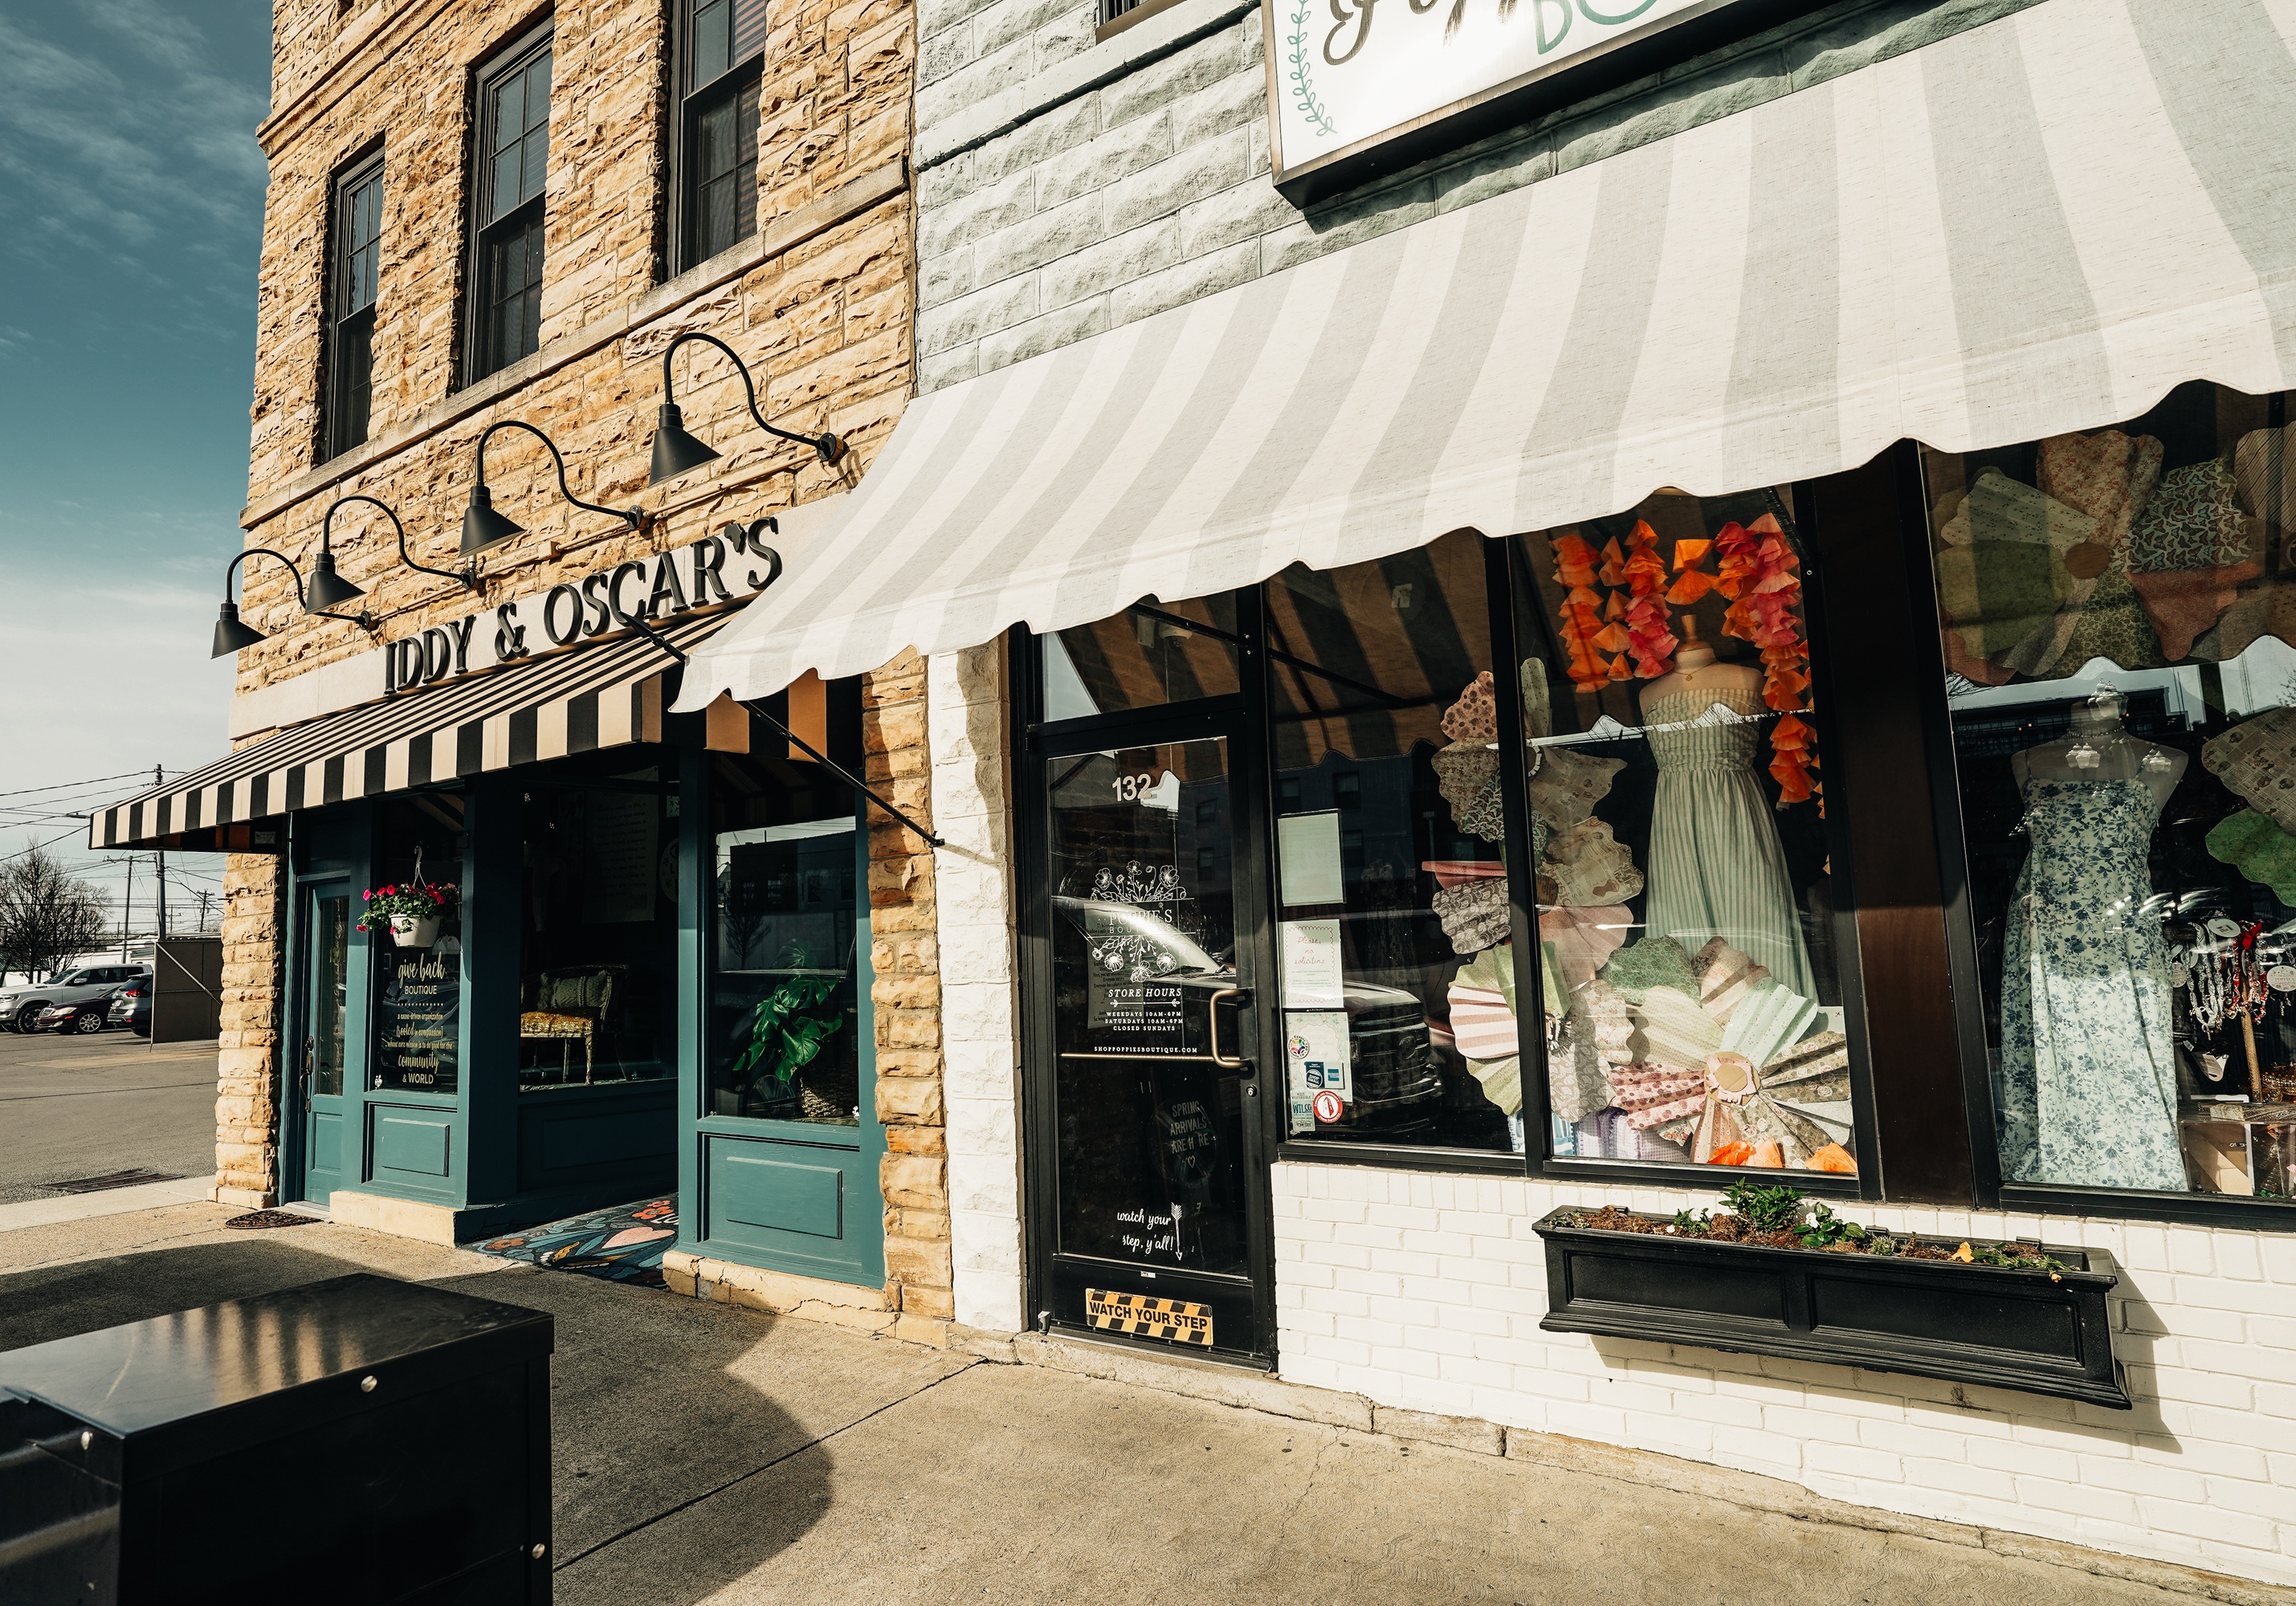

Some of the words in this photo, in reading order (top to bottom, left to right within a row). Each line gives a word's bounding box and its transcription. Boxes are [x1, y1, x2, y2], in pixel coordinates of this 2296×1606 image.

[384, 613, 475, 695] IDDY
[495, 601, 530, 661] &
[543, 516, 783, 646] OSCAR'S
[1112, 773, 1152, 801] 132
[1109, 909, 1172, 925] POPIE'S
[398, 959, 418, 988] give
[419, 952, 446, 981] back
[1295, 956, 1325, 966] soliciting
[404, 985, 438, 995] BOUTIQUE
[1108, 988, 1142, 997] STORE
[1145, 988, 1181, 997] HOURS
[422, 1012, 443, 1021] organization
[398, 1052, 439, 1074] community
[402, 1074, 407, 1082] &
[408, 1073, 434, 1084] WORLD
[1172, 1100, 1200, 1118] SPRING
[1170, 1115, 1207, 1136] ARRIVALS
[1172, 1138, 1187, 1154] ARE
[1188, 1132, 1209, 1150] HRE
[1117, 1208, 1144, 1223] watch
[1147, 1215, 1172, 1229] your
[1122, 1234, 1144, 1253] step,
[1145, 1234, 1173, 1254] y'all!
[1089, 1301, 1132, 1319] WATCH
[1135, 1308, 1170, 1325] YOUR
[1173, 1314, 1208, 1330] STEP
